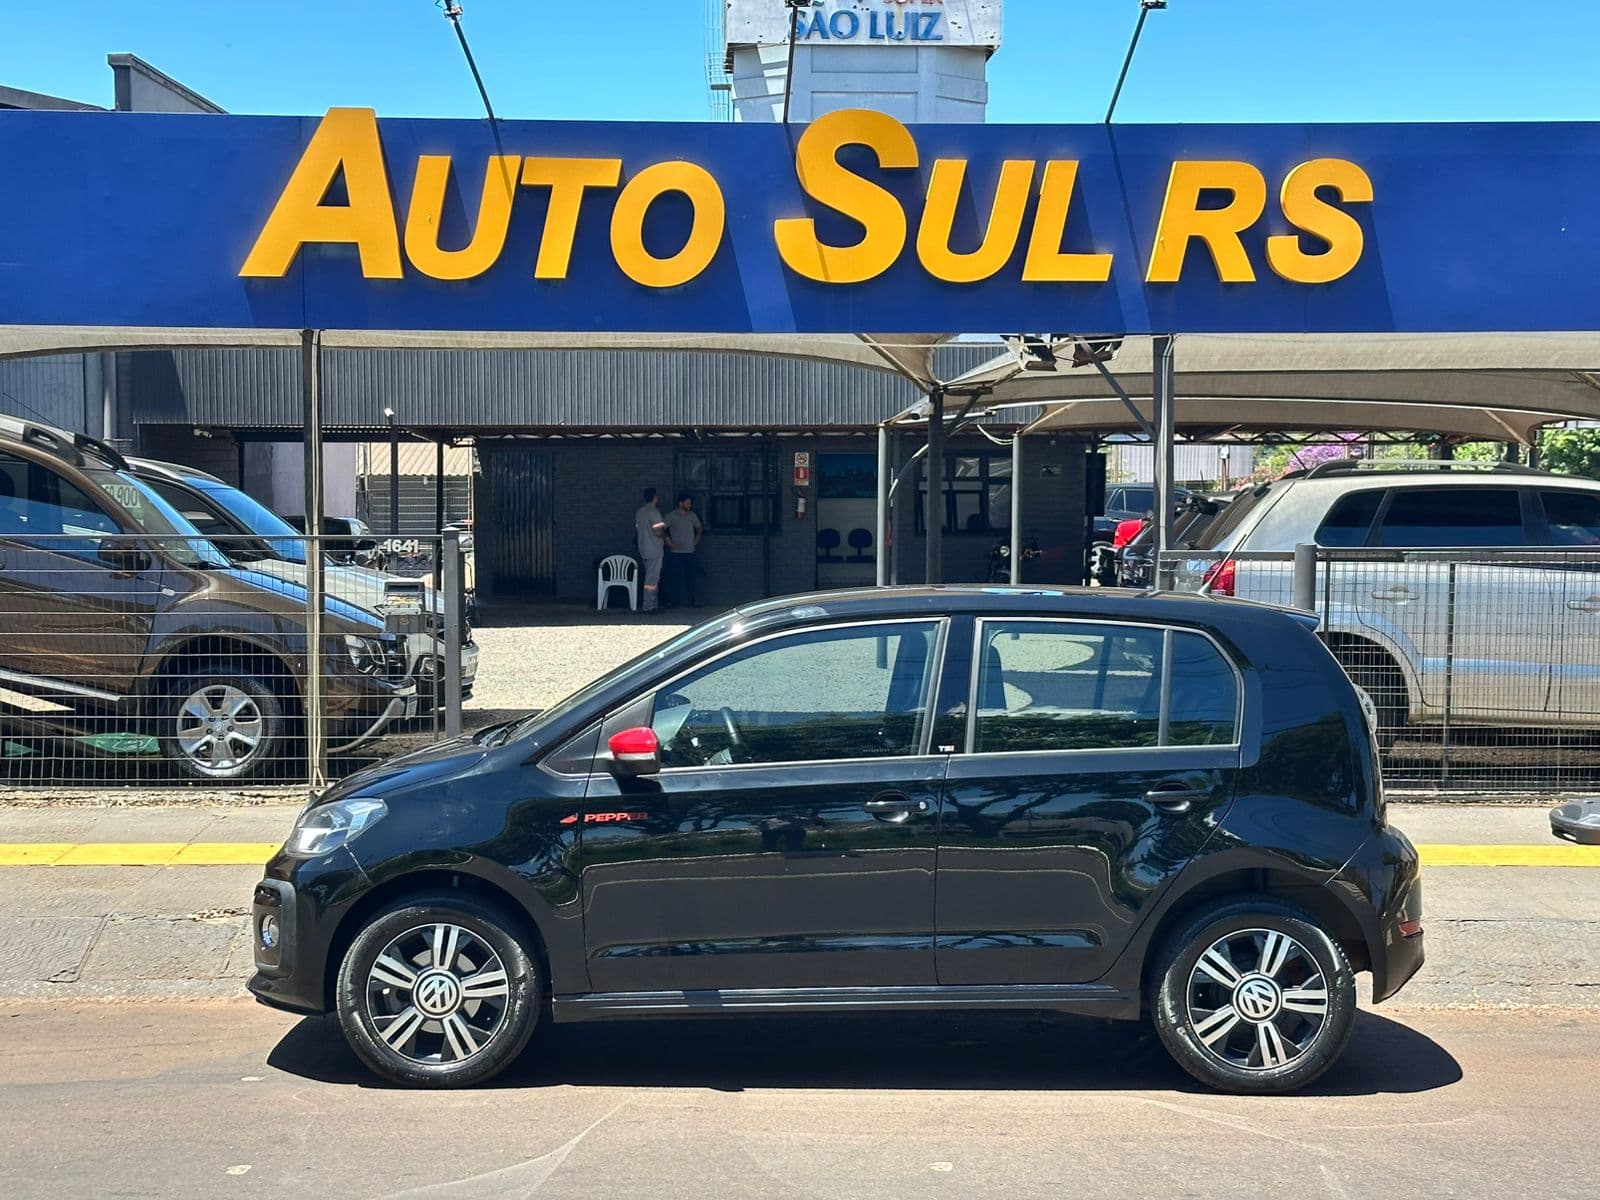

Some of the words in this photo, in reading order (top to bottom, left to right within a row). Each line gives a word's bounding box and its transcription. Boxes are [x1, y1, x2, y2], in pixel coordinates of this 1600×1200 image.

[787, 1, 859, 40] SÃO
[869, 10, 943, 41] LUIZ
[238, 107, 725, 288] AUTO
[774, 109, 1114, 283] SUL
[1145, 158, 1374, 284] RS
[383, 538, 419, 553] 1641
[584, 812, 648, 823] PEPPER
